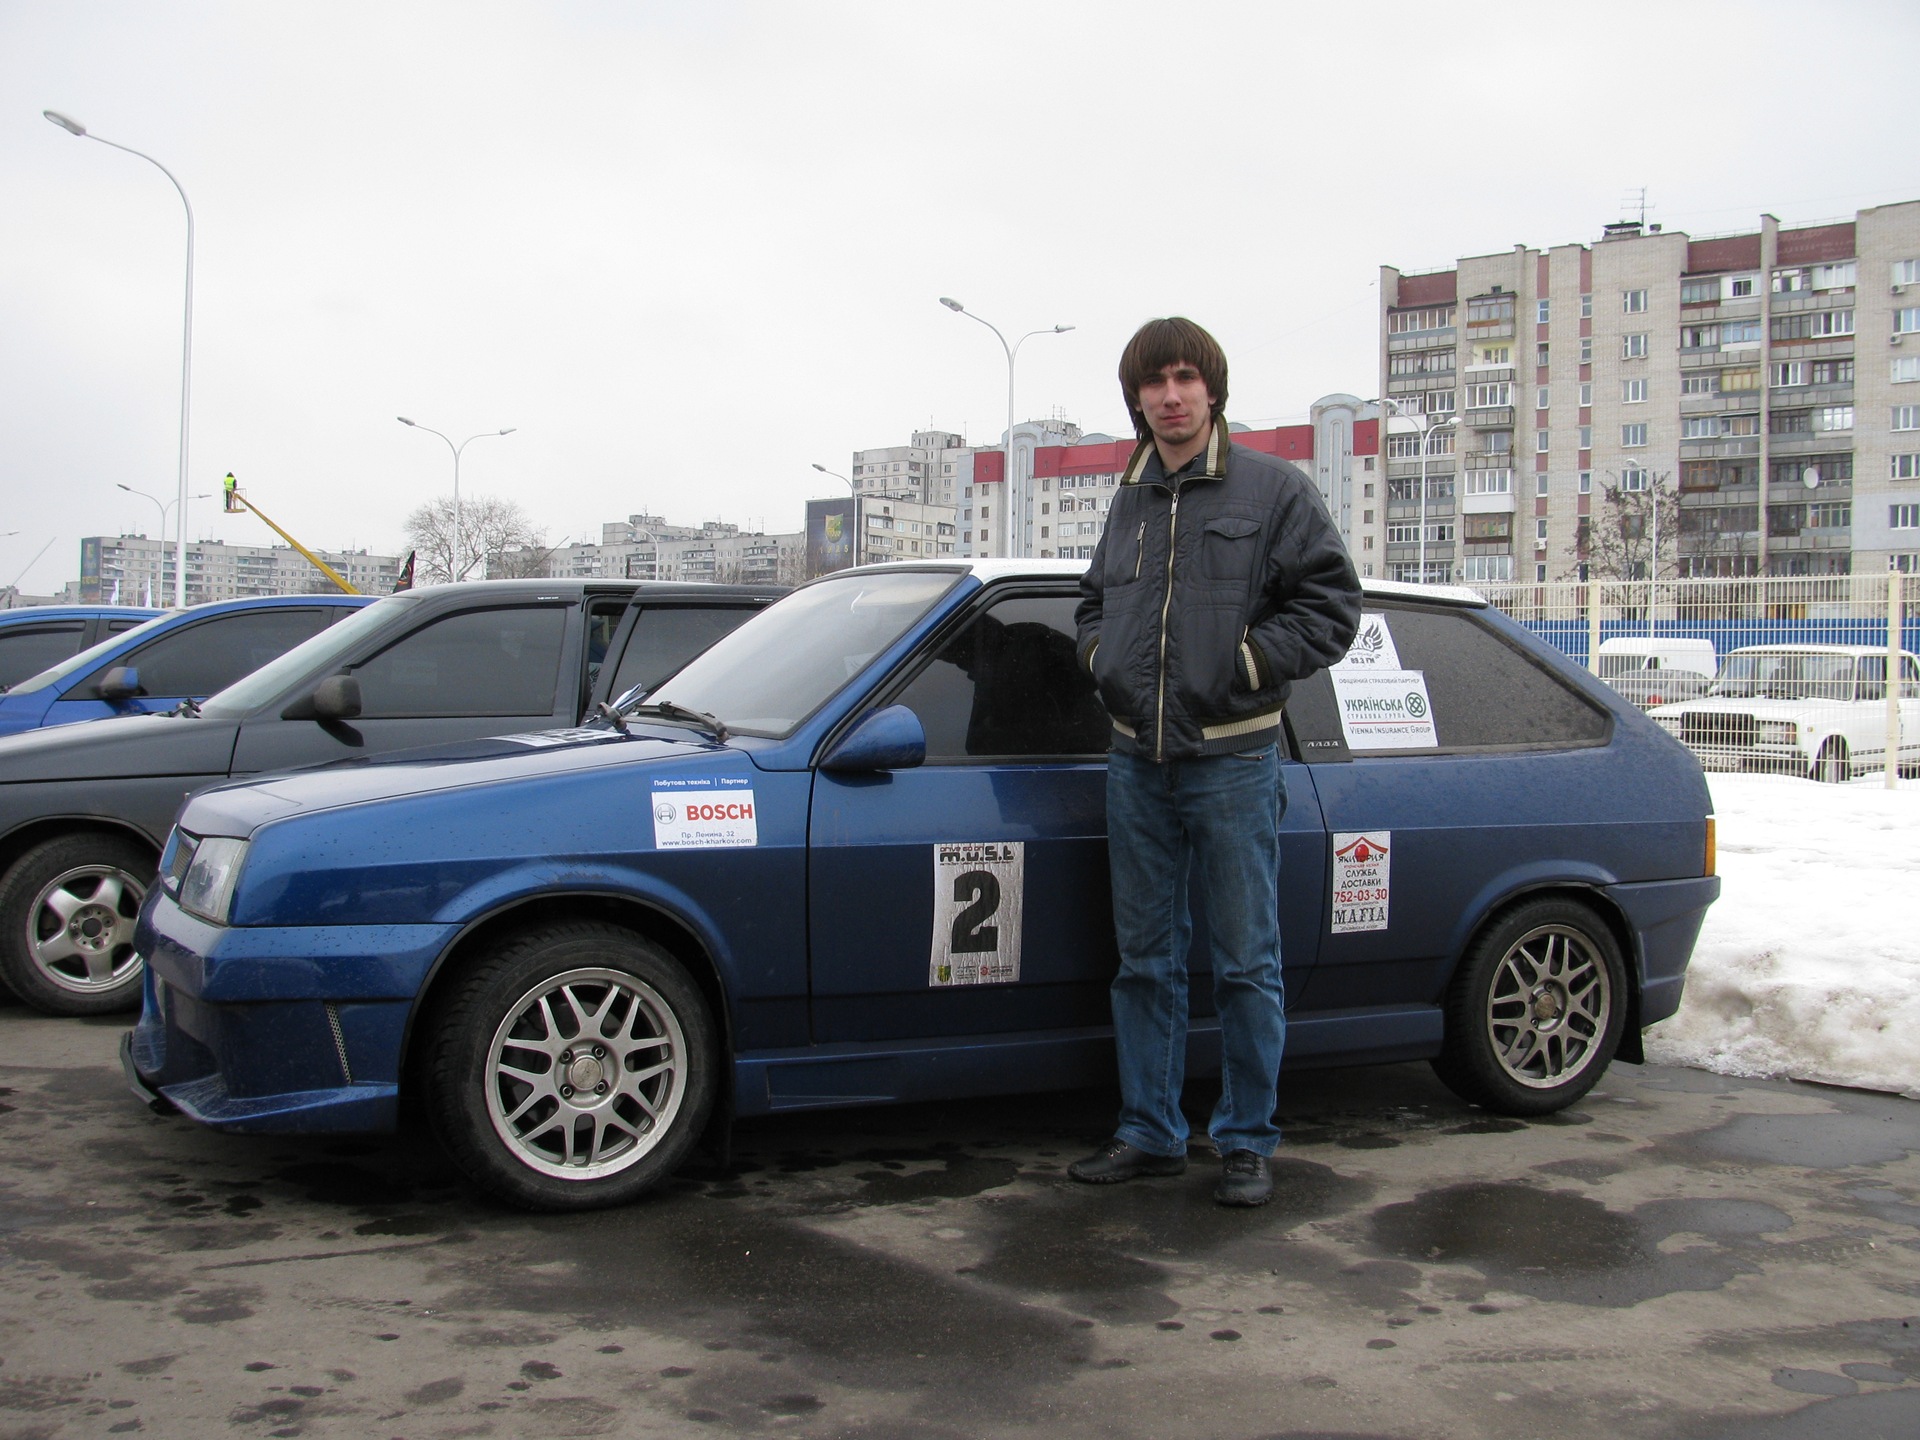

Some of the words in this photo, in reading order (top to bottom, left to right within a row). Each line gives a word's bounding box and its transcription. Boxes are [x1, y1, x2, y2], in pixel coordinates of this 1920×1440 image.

[1344, 696, 1404, 711] УКРАЇНСЬКА
[686, 804, 753, 821] BOSCH
[662, 838, 752, 846] www.bosch-kharkov.com
[1338, 853, 1384, 864] ЯКИРИЯ
[1345, 869, 1378, 878] СЛУЖБА
[1341, 879, 1382, 889] ДОСТАВКИ
[1334, 888, 1387, 903] 752-03-30
[951, 870, 1000, 953] 2
[1334, 907, 1385, 924] MAFIA
